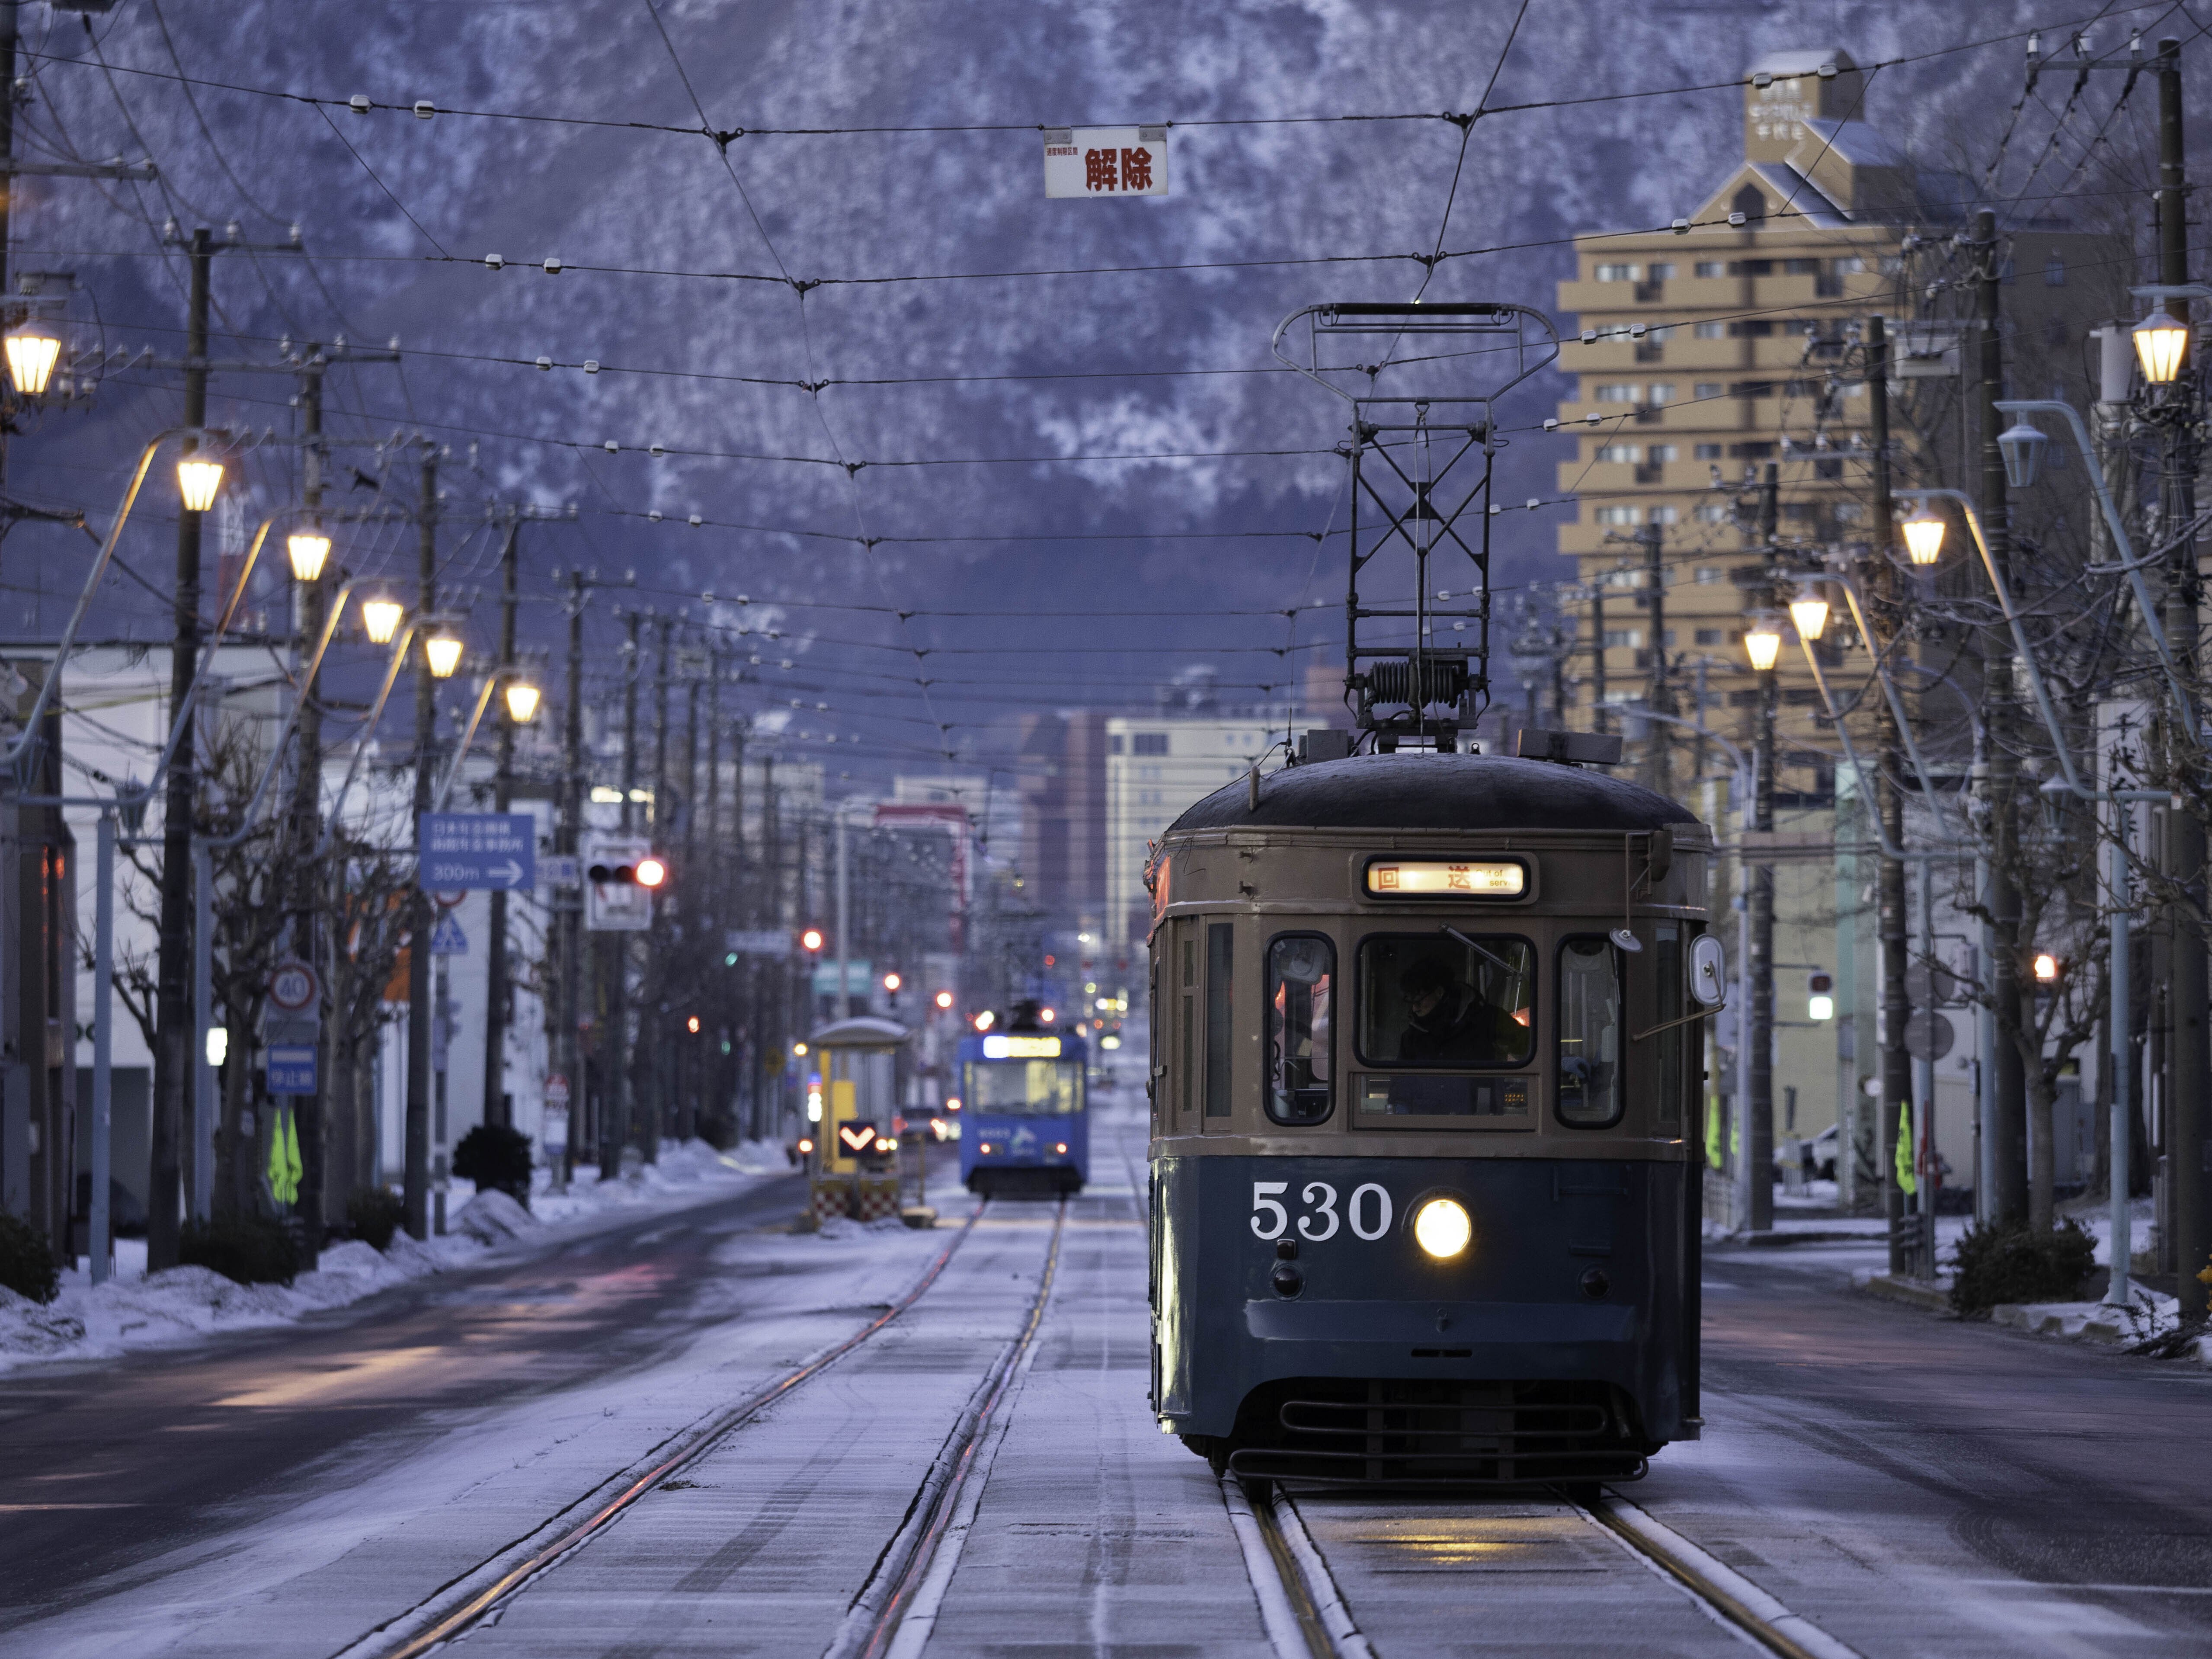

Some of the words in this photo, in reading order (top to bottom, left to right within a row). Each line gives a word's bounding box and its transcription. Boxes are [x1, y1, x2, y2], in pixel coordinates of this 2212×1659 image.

[1085, 147, 1153, 191] 解除
[433, 865, 479, 881] 300m
[280, 977, 305, 995] 40
[1250, 1182, 1393, 1242] 530
